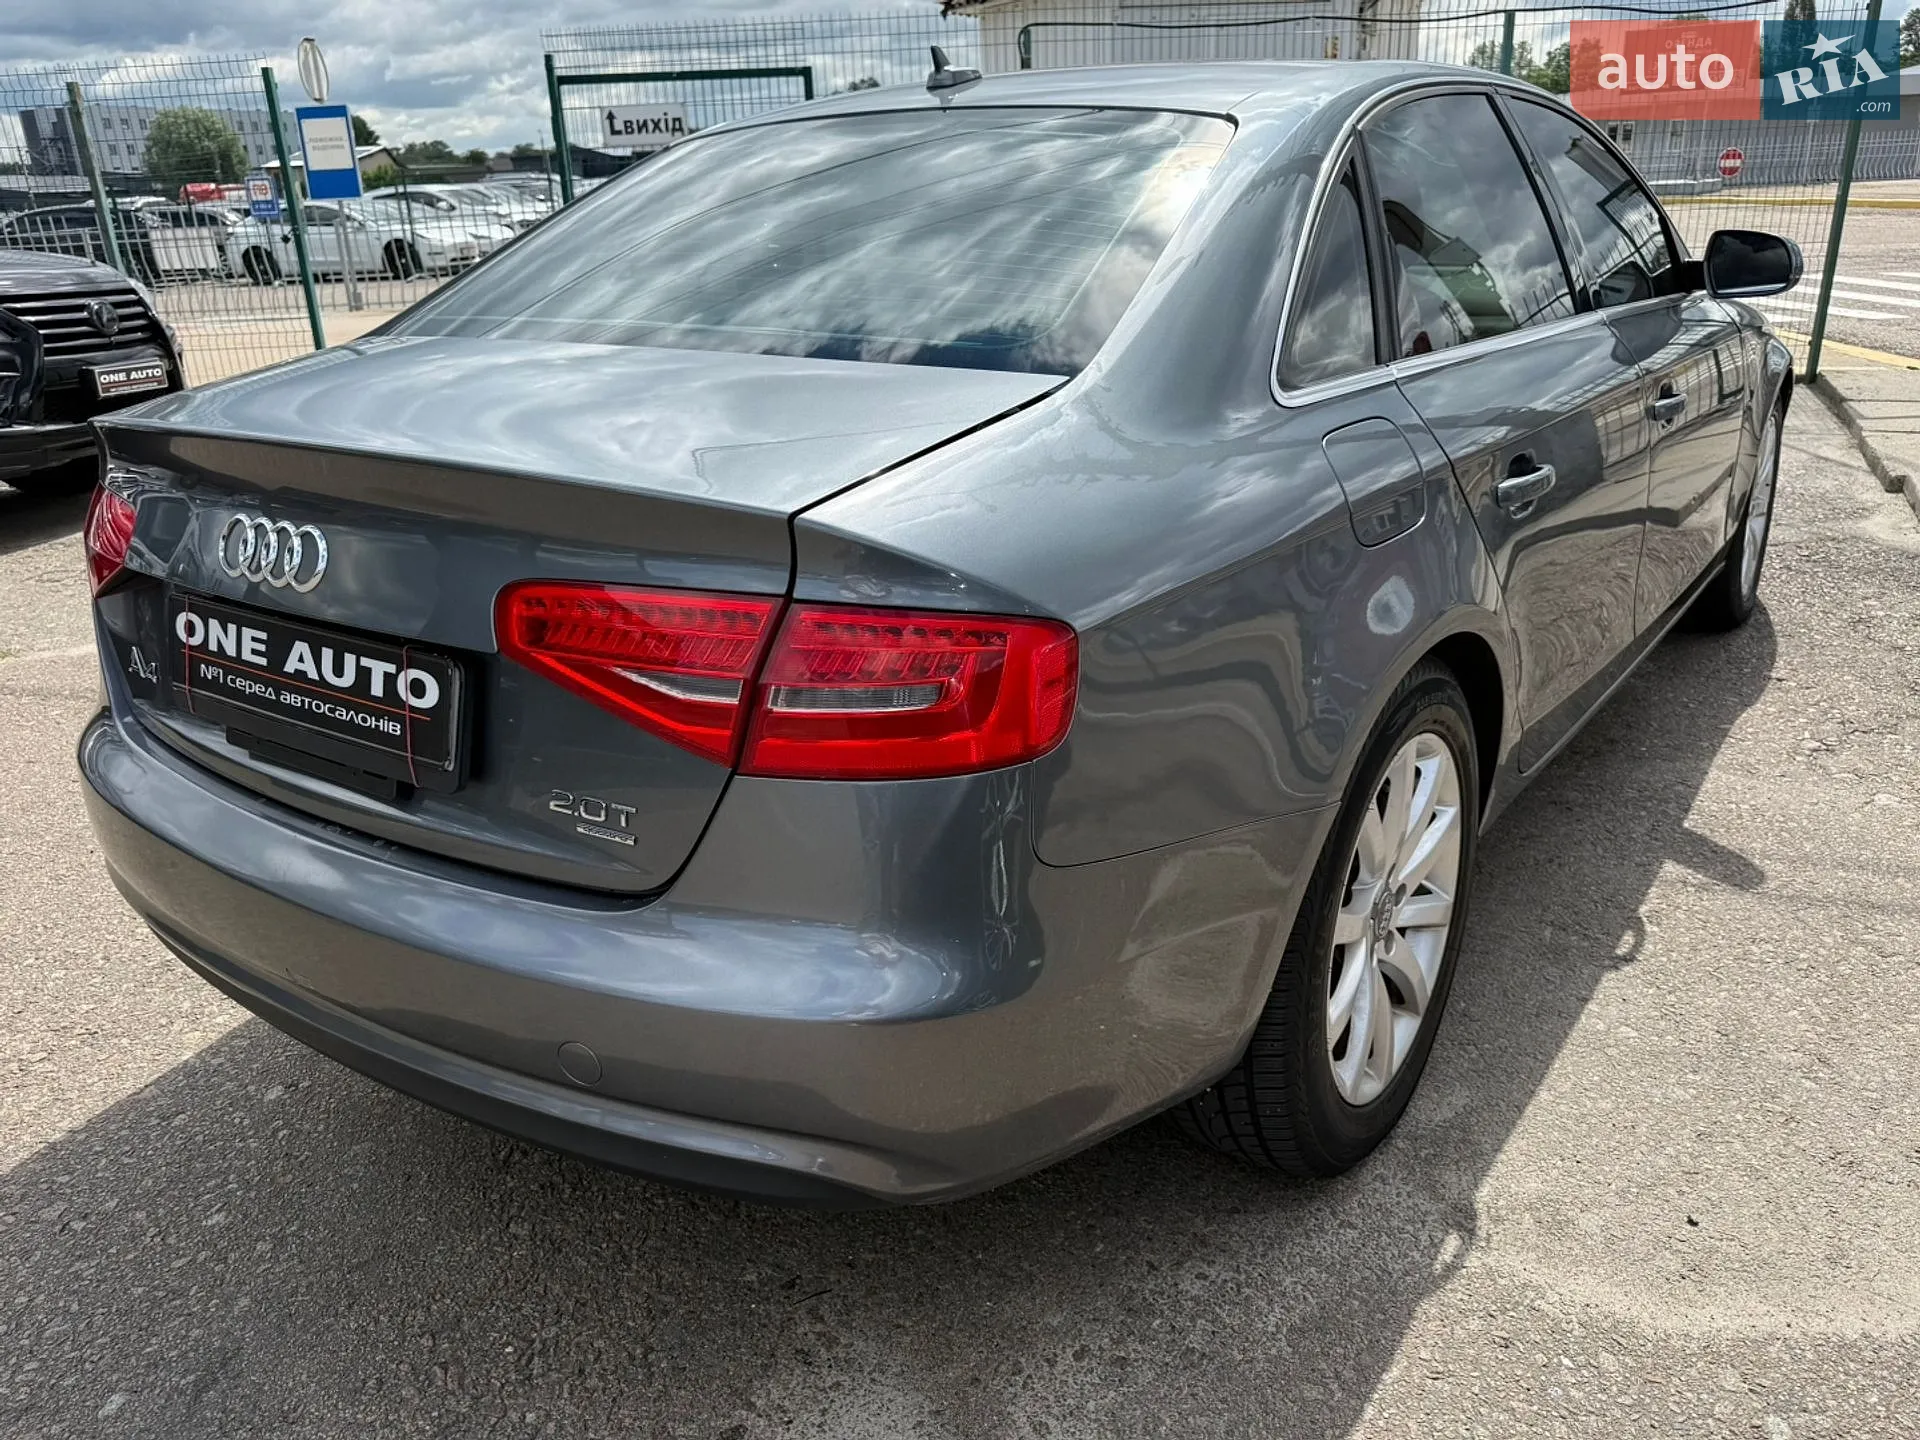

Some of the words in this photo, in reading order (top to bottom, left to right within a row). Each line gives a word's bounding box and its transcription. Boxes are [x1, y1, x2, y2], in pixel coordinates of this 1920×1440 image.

[100, 372, 128, 383] ONE
[130, 368, 162, 380] AUTO
[175, 611, 268, 667] ONE
[283, 640, 440, 709] AUTO
[227, 674, 276, 700] серед
[280, 690, 401, 736] автосалонів
[549, 789, 638, 828] 2.0T
